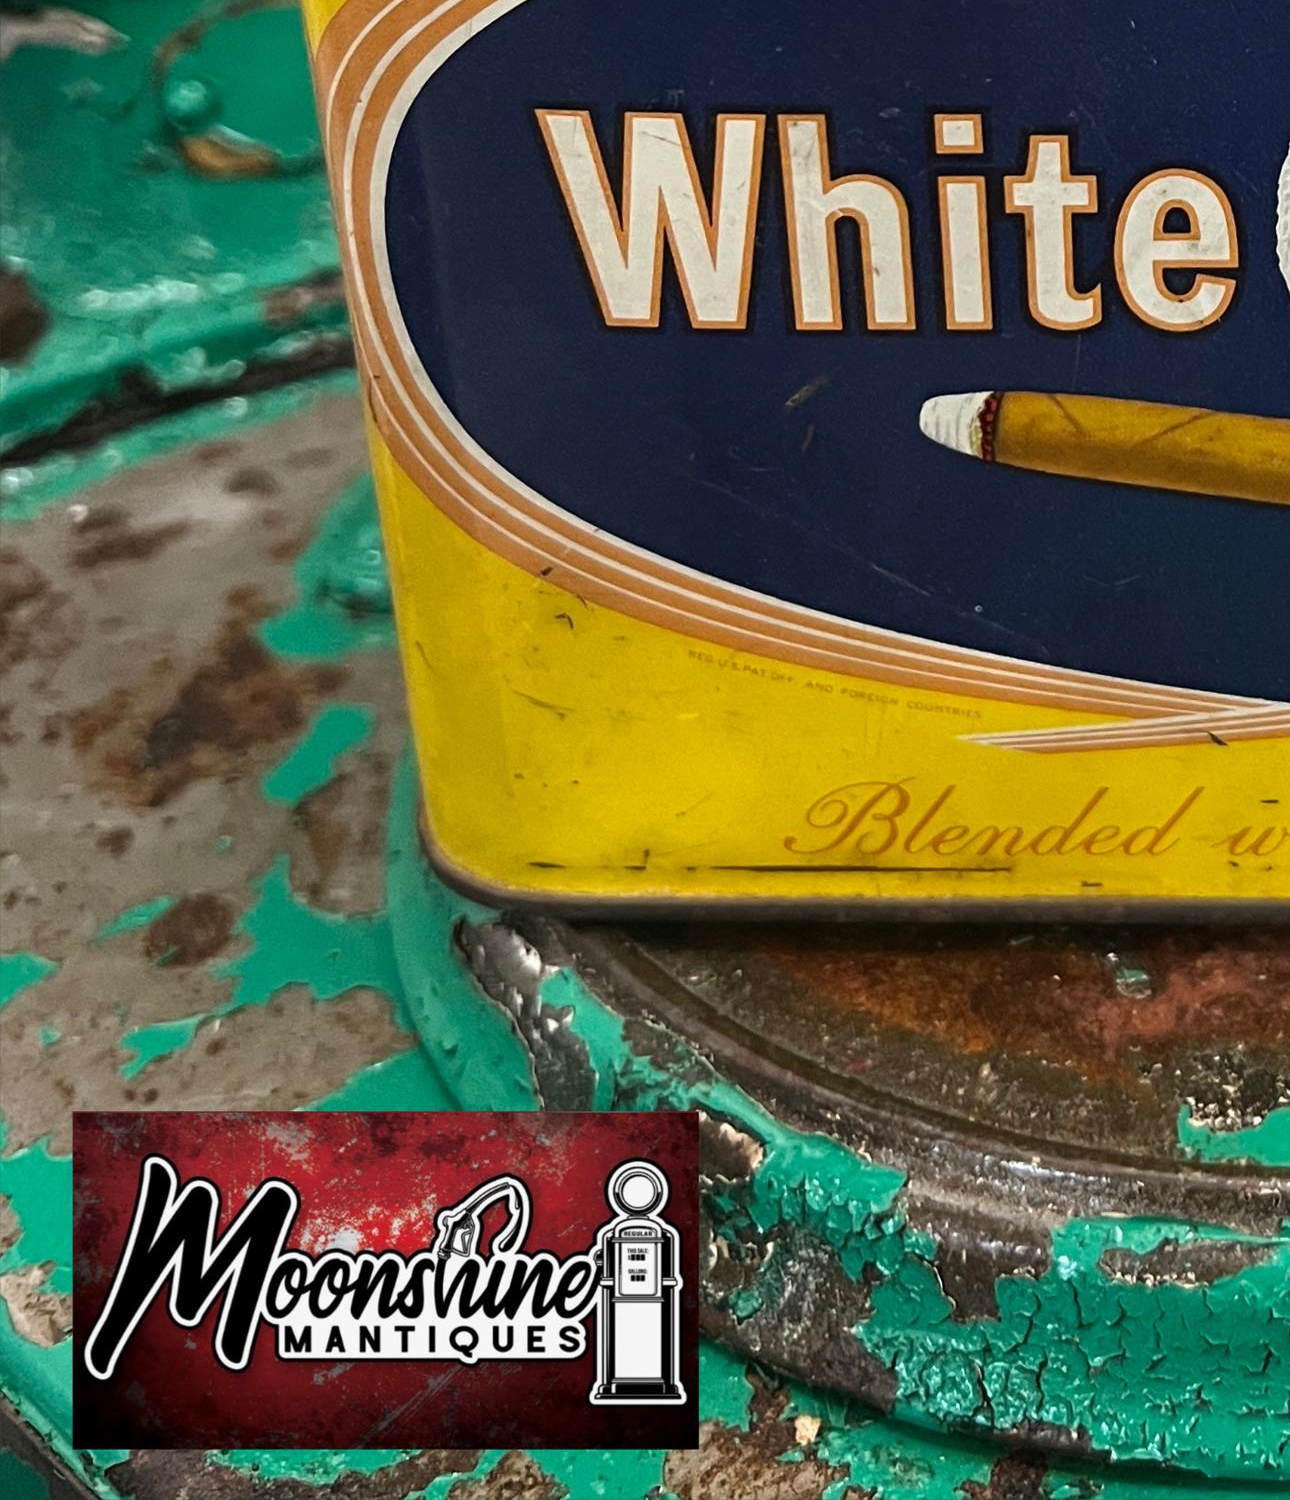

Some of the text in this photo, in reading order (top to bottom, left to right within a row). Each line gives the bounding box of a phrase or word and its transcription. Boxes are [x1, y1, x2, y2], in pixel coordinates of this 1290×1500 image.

[533, 107, 1241, 335] White
[804, 679, 834, 693] AND
[840, 686, 899, 706] FOREIGN
[906, 699, 982, 719] COUNTRIES
[783, 775, 1204, 860] Blended
